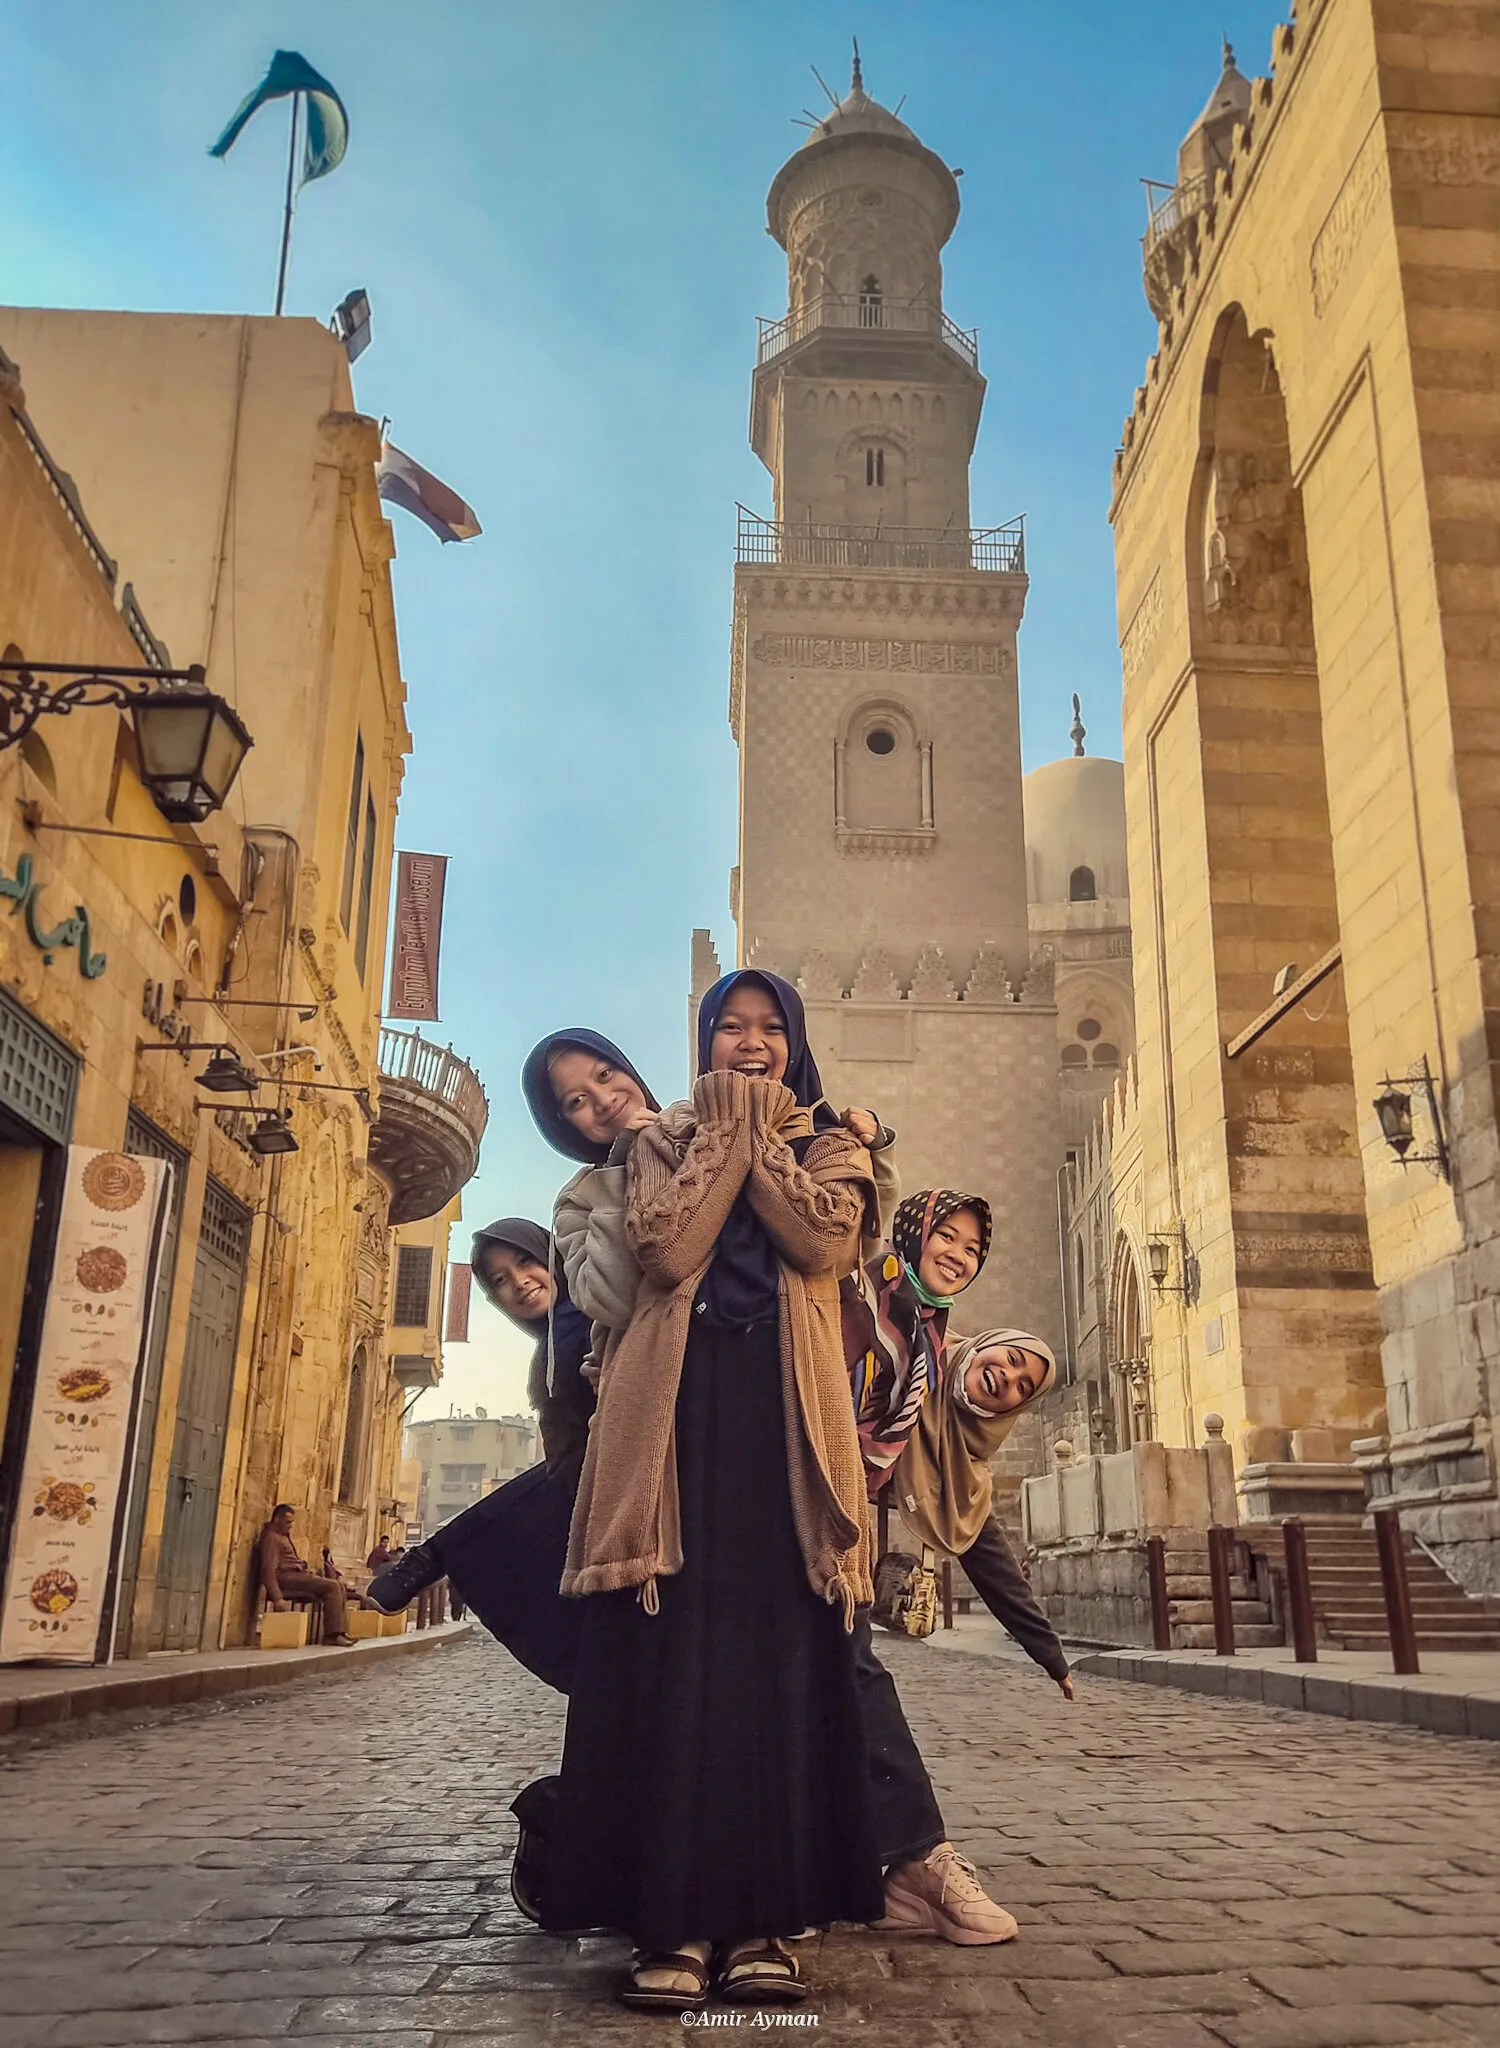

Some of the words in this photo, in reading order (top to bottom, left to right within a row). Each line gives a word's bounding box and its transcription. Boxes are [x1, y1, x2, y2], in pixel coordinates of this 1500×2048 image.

[402, 860, 434, 911] Museum
[400, 913, 429, 953] Textile
[396, 957, 433, 1011] Egyptian
